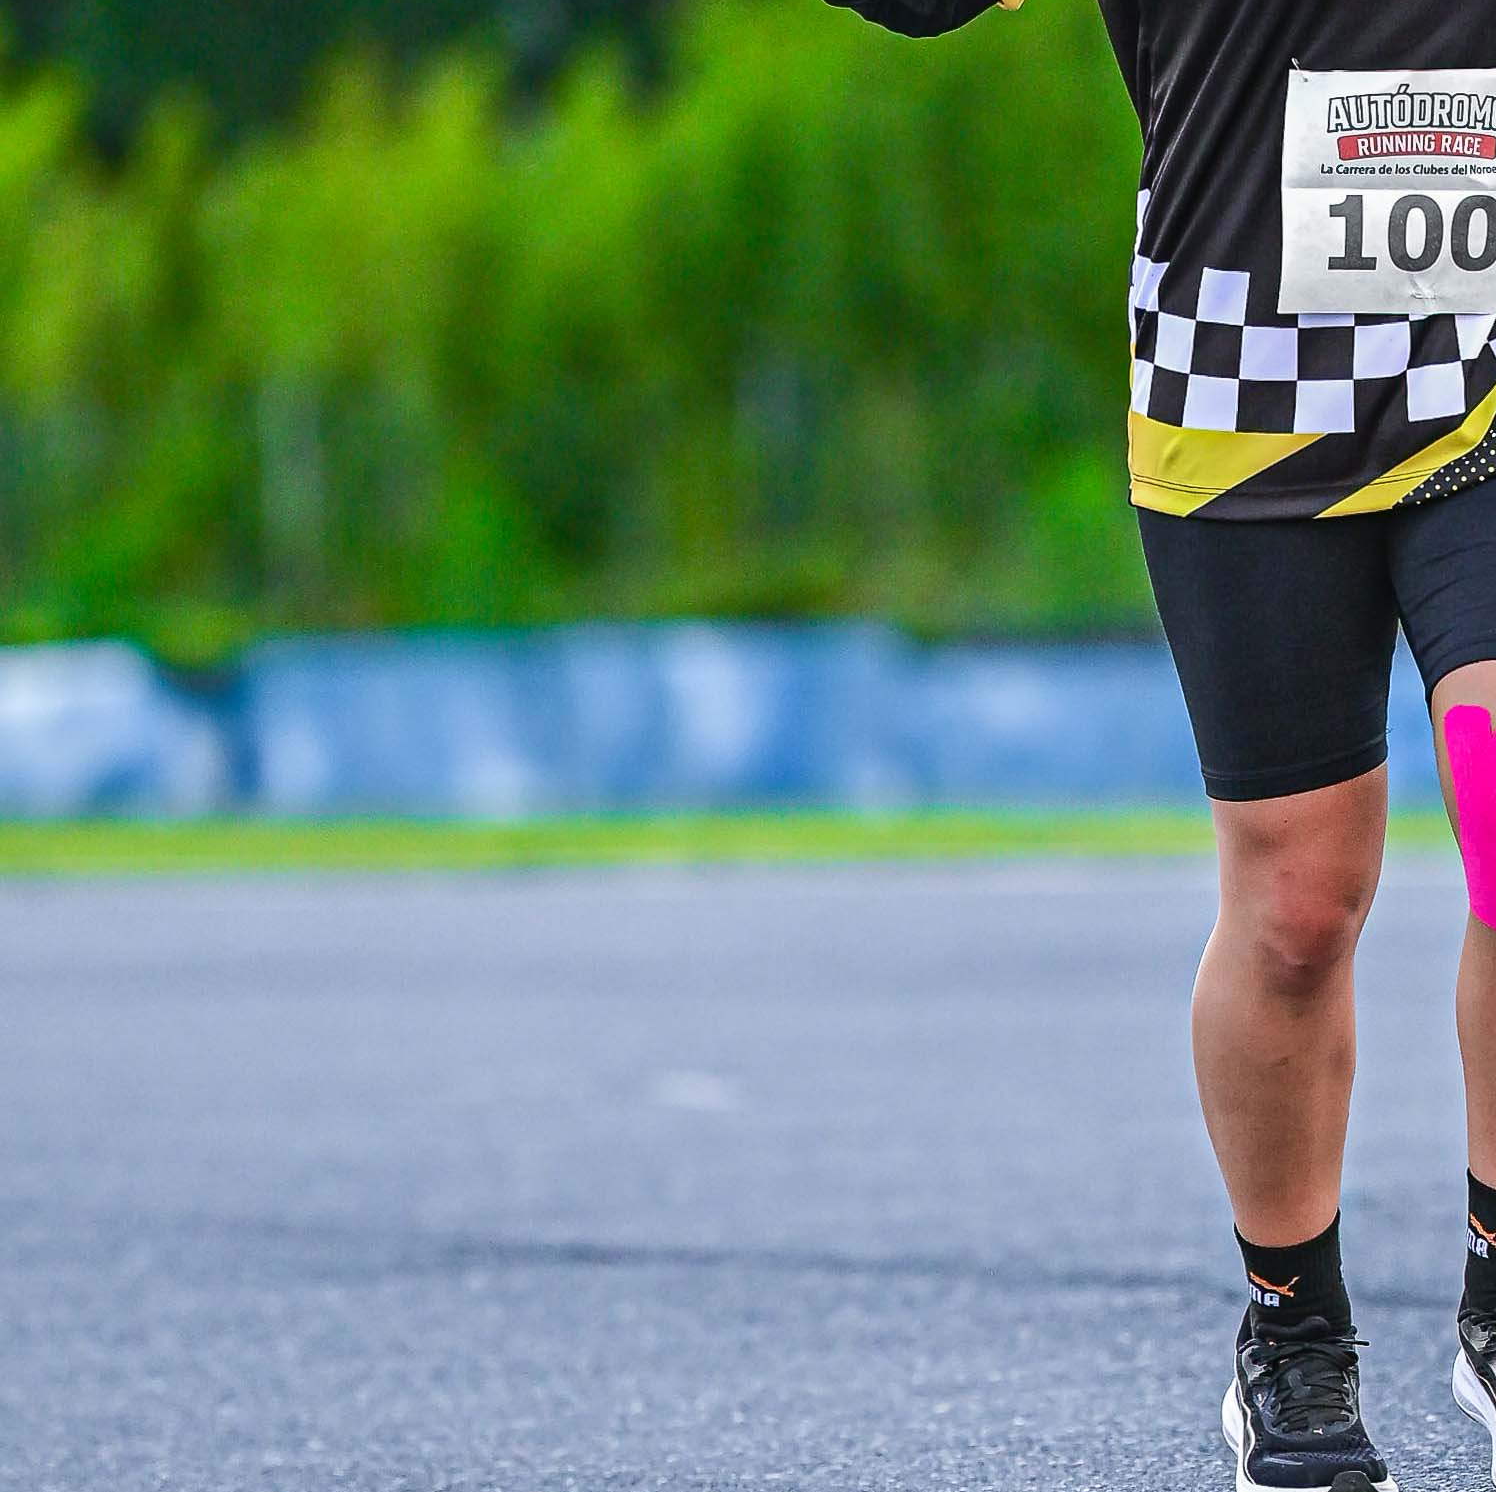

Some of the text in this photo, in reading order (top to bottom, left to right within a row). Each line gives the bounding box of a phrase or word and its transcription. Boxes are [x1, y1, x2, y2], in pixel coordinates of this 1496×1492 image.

[1356, 134, 1483, 157] RUNNING RACE
[1320, 163, 1333, 175] La
[1335, 164, 1376, 175] Carrera
[1379, 164, 1393, 175] de
[1395, 163, 1411, 175] los
[1413, 164, 1448, 175] Clubes
[1450, 164, 1468, 176] del
